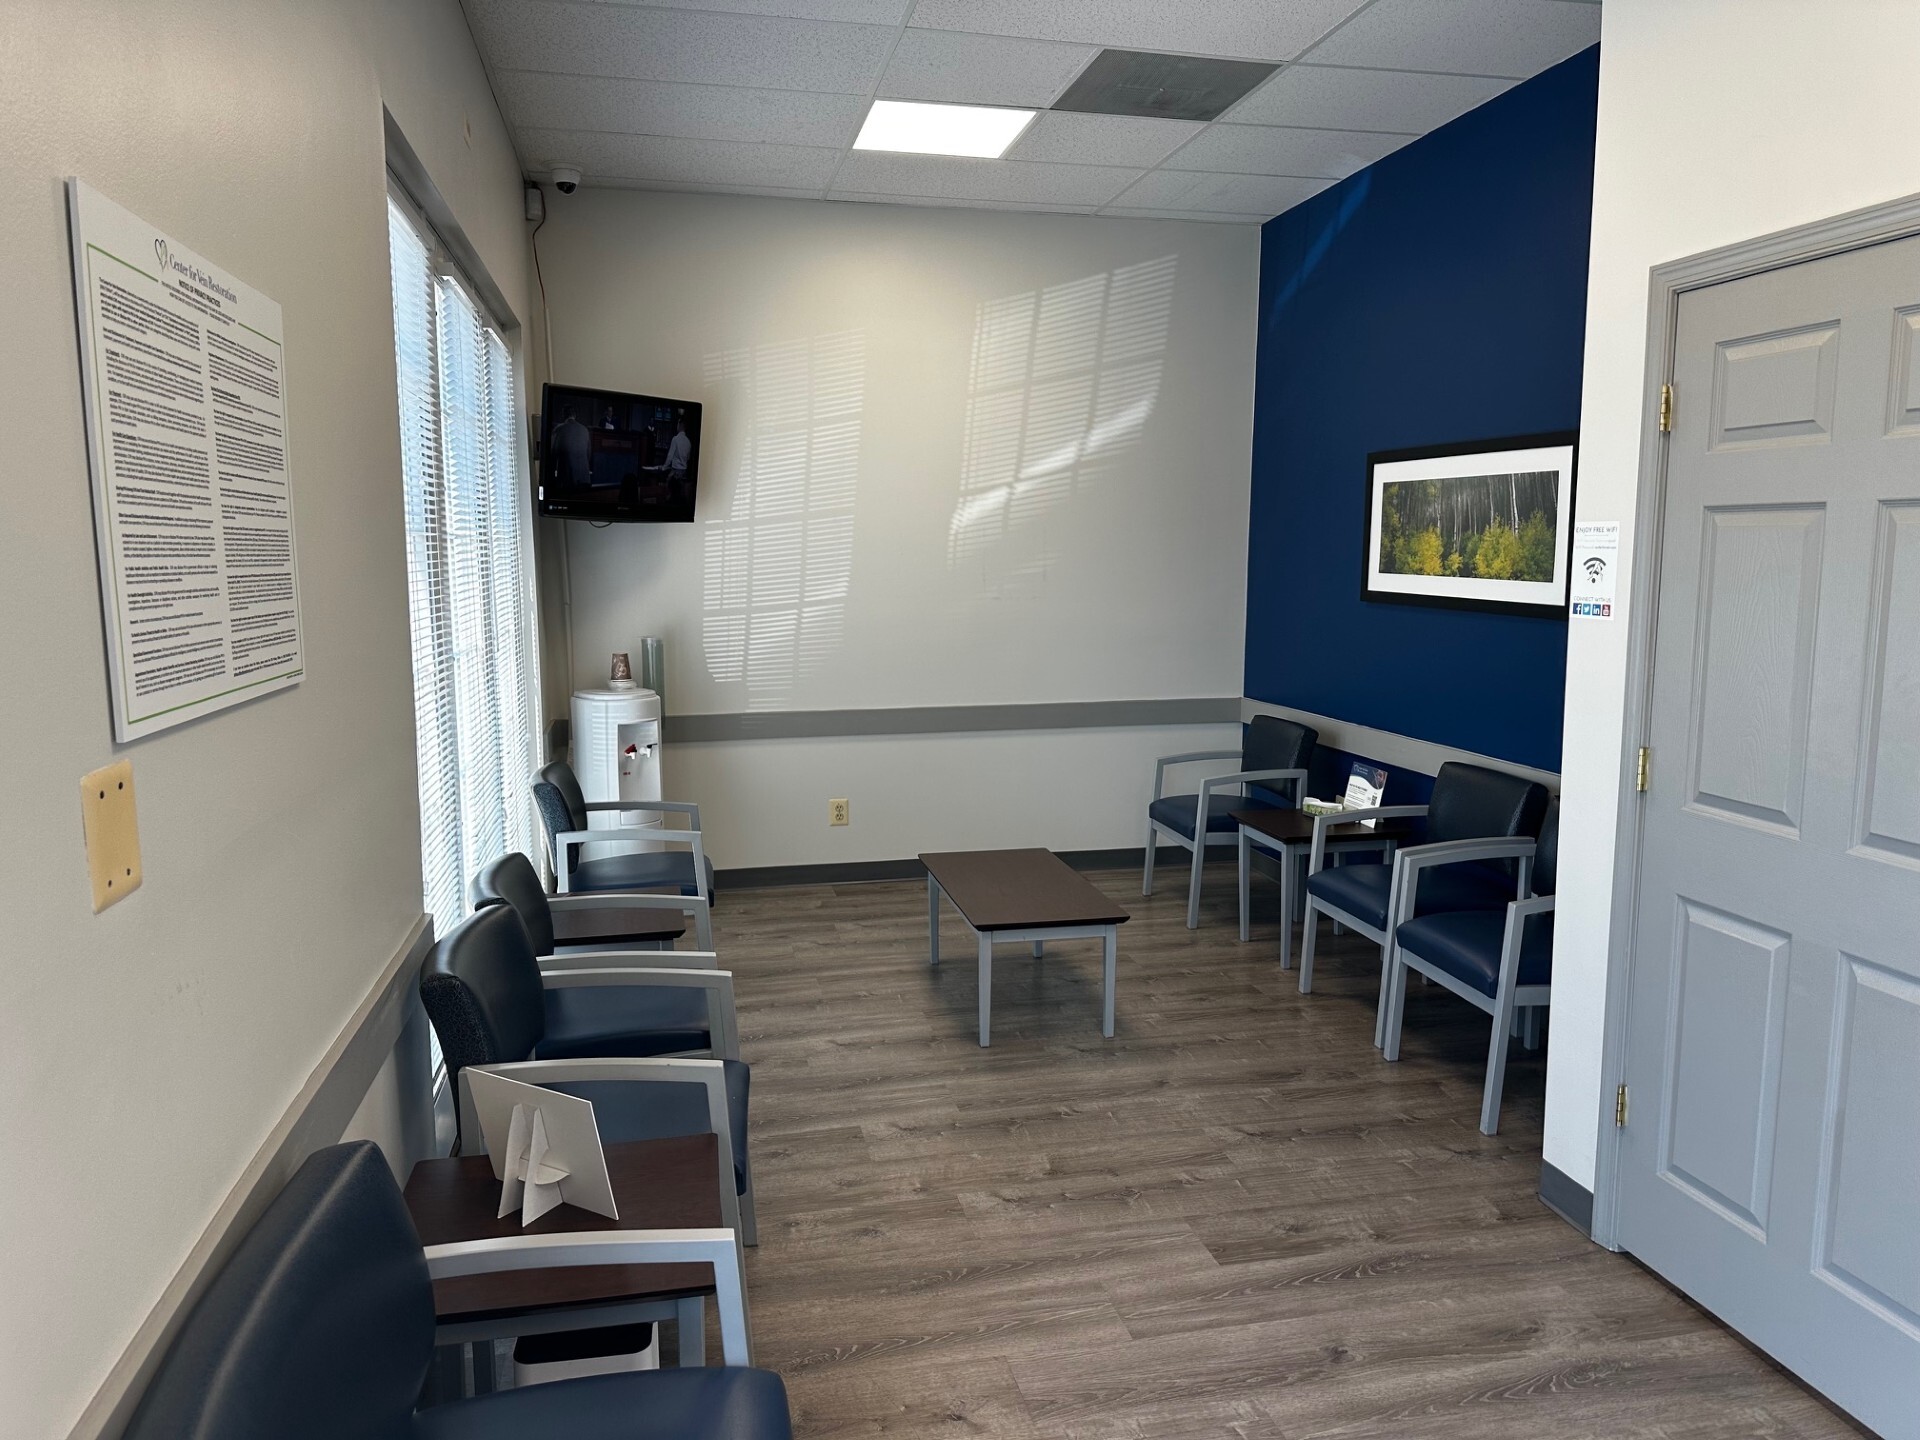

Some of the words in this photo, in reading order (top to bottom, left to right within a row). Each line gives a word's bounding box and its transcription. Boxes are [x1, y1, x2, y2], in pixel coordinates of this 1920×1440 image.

[170, 253, 188, 276] Center
[197, 268, 208, 288] Vein
[208, 275, 237, 304] Restoration
